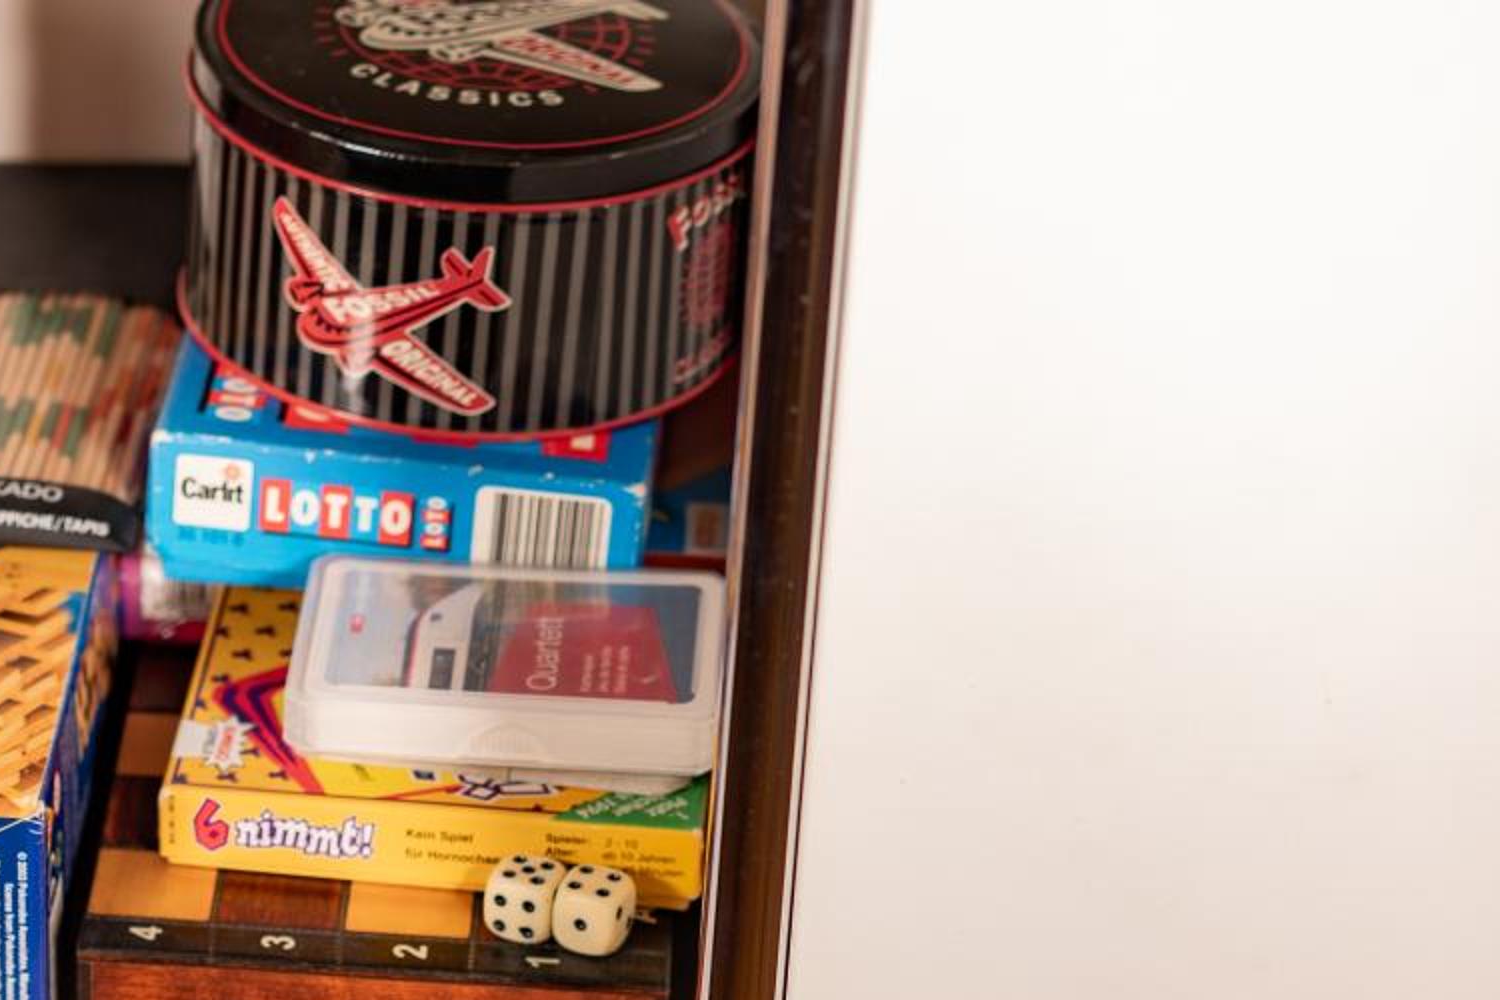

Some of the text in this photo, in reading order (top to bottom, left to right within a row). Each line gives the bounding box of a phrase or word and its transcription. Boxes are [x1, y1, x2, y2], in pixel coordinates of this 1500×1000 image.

[350, 63, 565, 108] CLASSICS
[322, 283, 440, 323] FOSSIL
[380, 339, 478, 407] ORIGINAL
[262, 484, 413, 537] LOTTO
[525, 616, 565, 691] Quartett
[193, 798, 231, 852] 6
[234, 809, 375, 859] nimmt!
[405, 828, 474, 844] Kein Spiel
[128, 923, 563, 969] 4 3 2 1
